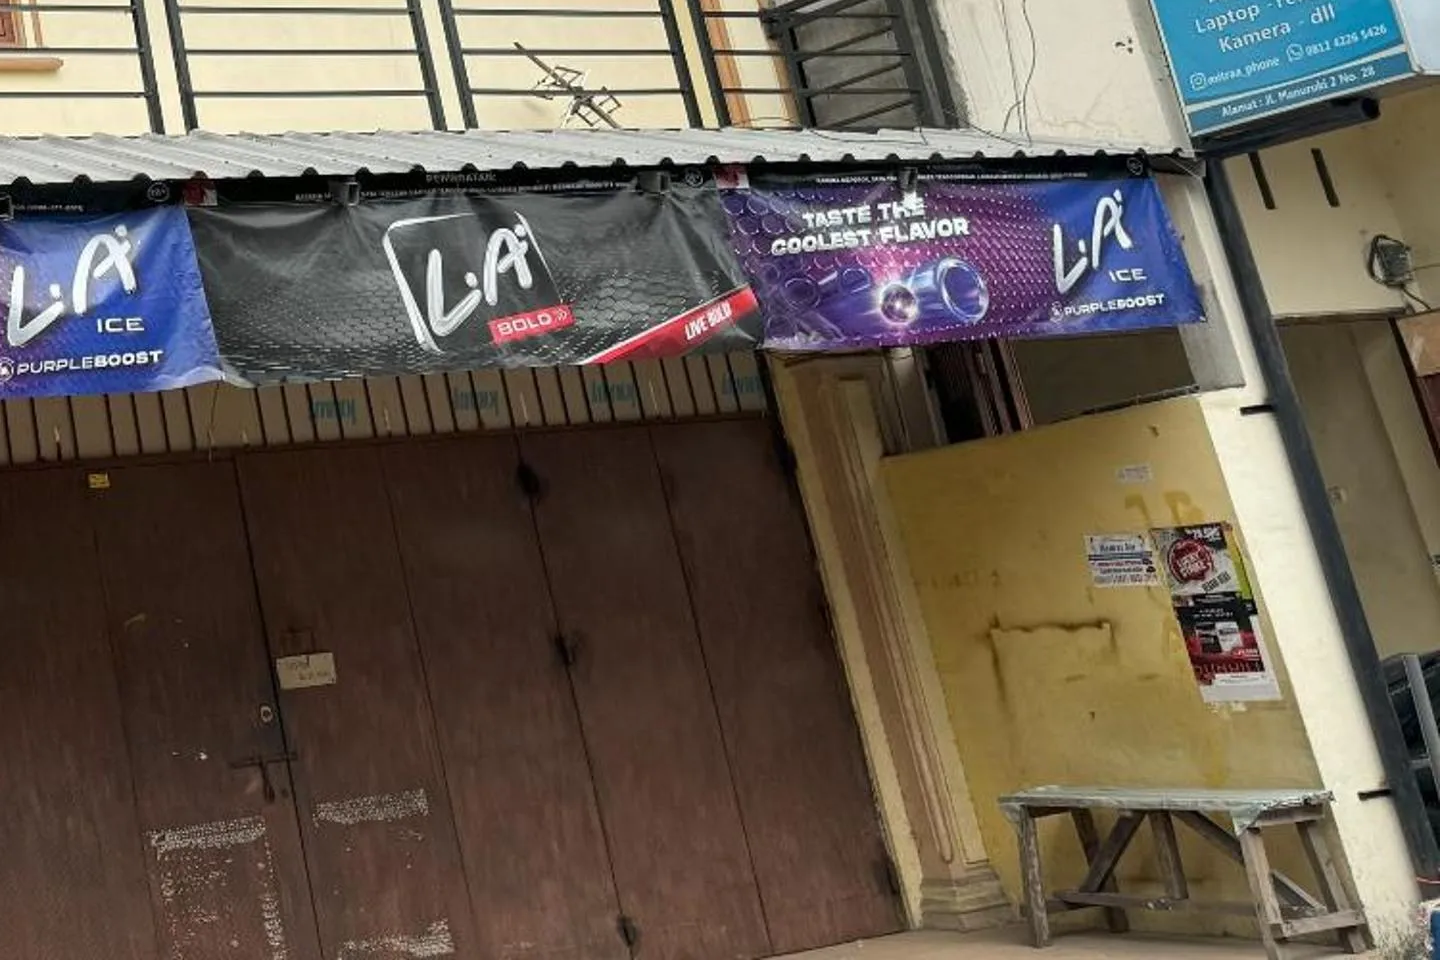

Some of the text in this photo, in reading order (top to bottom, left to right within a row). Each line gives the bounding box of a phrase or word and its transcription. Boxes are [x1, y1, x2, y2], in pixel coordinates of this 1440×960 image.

[1195, 3, 1260, 33] Laptop
[1219, 22, 1290, 53] Kamera
[1311, 3, 1335, 24] dll
[802, 198, 925, 228] TASTE THE
[771, 217, 969, 256] COOLEST FLAVOR
[1109, 268, 1148, 282] ICE
[1064, 293, 1164, 316] PURPLEBOOST
[96, 318, 145, 333] ICE
[497, 313, 552, 335] BOLD
[684, 301, 732, 340] LIVE BOLD
[17, 350, 164, 375] PURPLEBOOST
